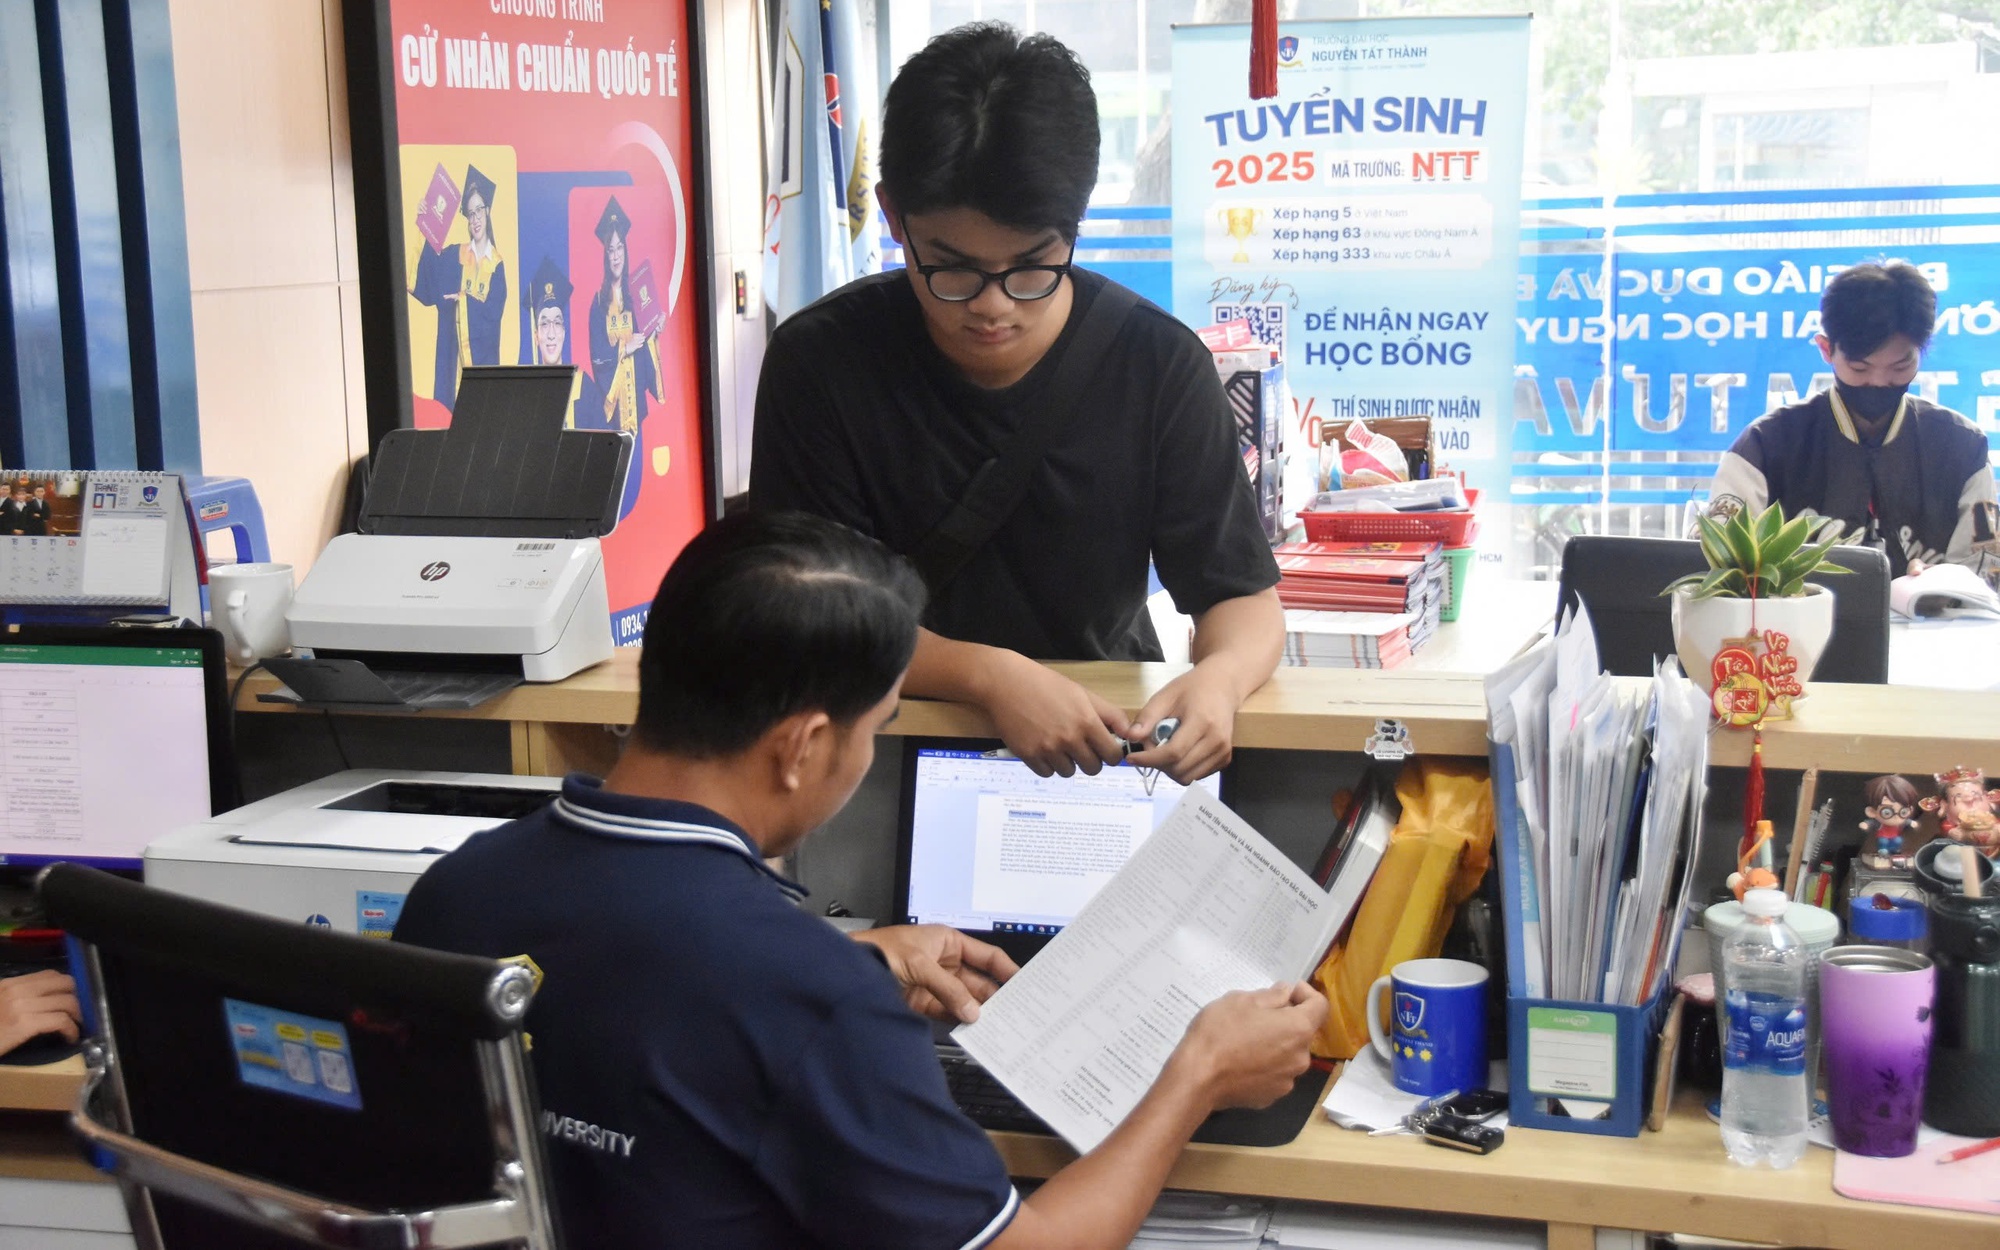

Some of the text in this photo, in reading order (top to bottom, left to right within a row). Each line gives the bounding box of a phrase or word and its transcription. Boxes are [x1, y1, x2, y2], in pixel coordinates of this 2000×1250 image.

[1312, 34, 1350, 46] TRƯỜNG
[402, 24, 677, 99] CỬ NHÂN CHUẨN QUỐC TẾ
[1311, 46, 1358, 62] NGUYỄN
[1361, 47, 1384, 60] TẤT
[1387, 44, 1427, 59] THÀNH
[1205, 87, 1487, 147] TUYỂN SINH
[1211, 150, 1480, 188] 2025 MÃ TRƯỜNG: NTT
[1272, 207, 1299, 221] Xếp
[1302, 207, 1339, 223] hạng
[1342, 207, 1352, 219] 5
[1384, 208, 1408, 218] Nam
[1272, 228, 1299, 242] Xếp
[1302, 227, 1339, 243] hạng
[1342, 226, 1361, 239] 63
[1414, 227, 1441, 241] Đông
[1444, 228, 1468, 238] Nam
[1272, 248, 1299, 263] Xếp
[1302, 248, 1339, 263] hạng
[1342, 247, 1370, 259] 333
[1414, 248, 1441, 259] Châu
[1208, 276, 1255, 303] Đăng
[1304, 306, 1489, 335] ĐỂ NHẬN NGAY
[1305, 334, 1471, 371] HỌC BỔNG
[1332, 395, 1355, 417] THÍ
[1358, 399, 1391, 417] SINH
[1438, 395, 1480, 423] NHẬN
[1440, 428, 1469, 450] VÀO
[92, 493, 117, 509] 07
[1479, 554, 1502, 563] HCM
[420, 561, 451, 582] hp
[621, 609, 648, 638] 0934.1
[1212, 816, 1221, 825] TÊN
[1220, 823, 1238, 839] NGÀNH
[1237, 837, 1246, 846] VÀ
[1245, 843, 1254, 852] MÃ
[1252, 850, 1270, 867] NGÀNH
[1269, 865, 1280, 875] ĐÀO
